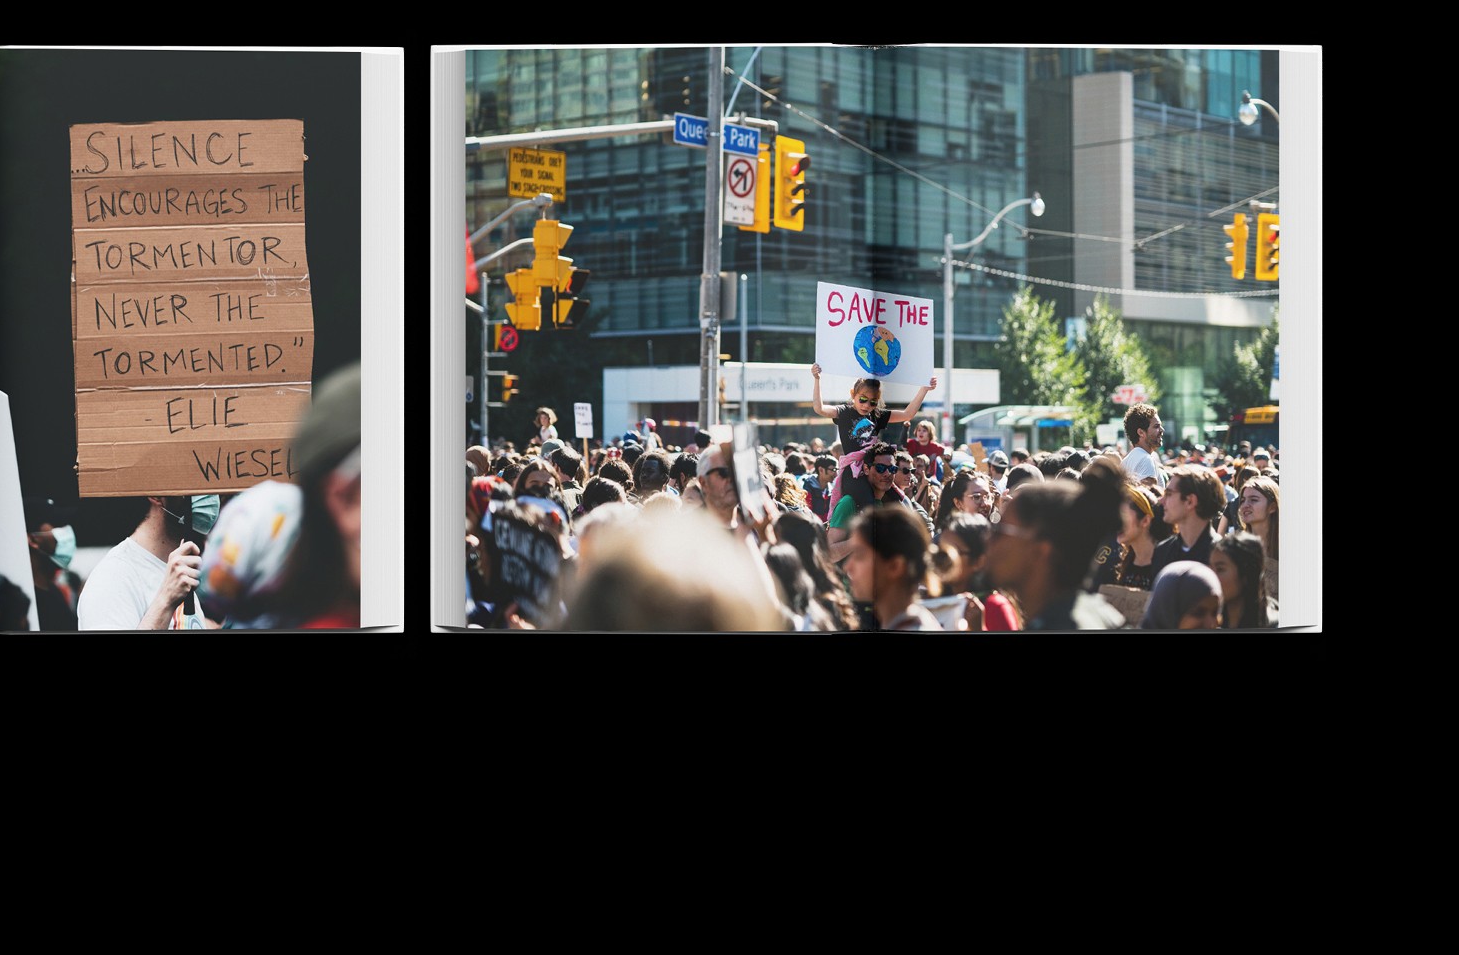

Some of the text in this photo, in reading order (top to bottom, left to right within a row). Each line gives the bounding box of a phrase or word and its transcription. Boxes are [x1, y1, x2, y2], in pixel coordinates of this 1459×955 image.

[730, 128, 756, 149] Park
[84, 183, 302, 223] ENCOURAGES THE
[94, 293, 265, 330] NEVER THE
[827, 291, 929, 328] SAVE THE
[165, 395, 249, 434] ELIE
[192, 446, 300, 481] WIESEL
